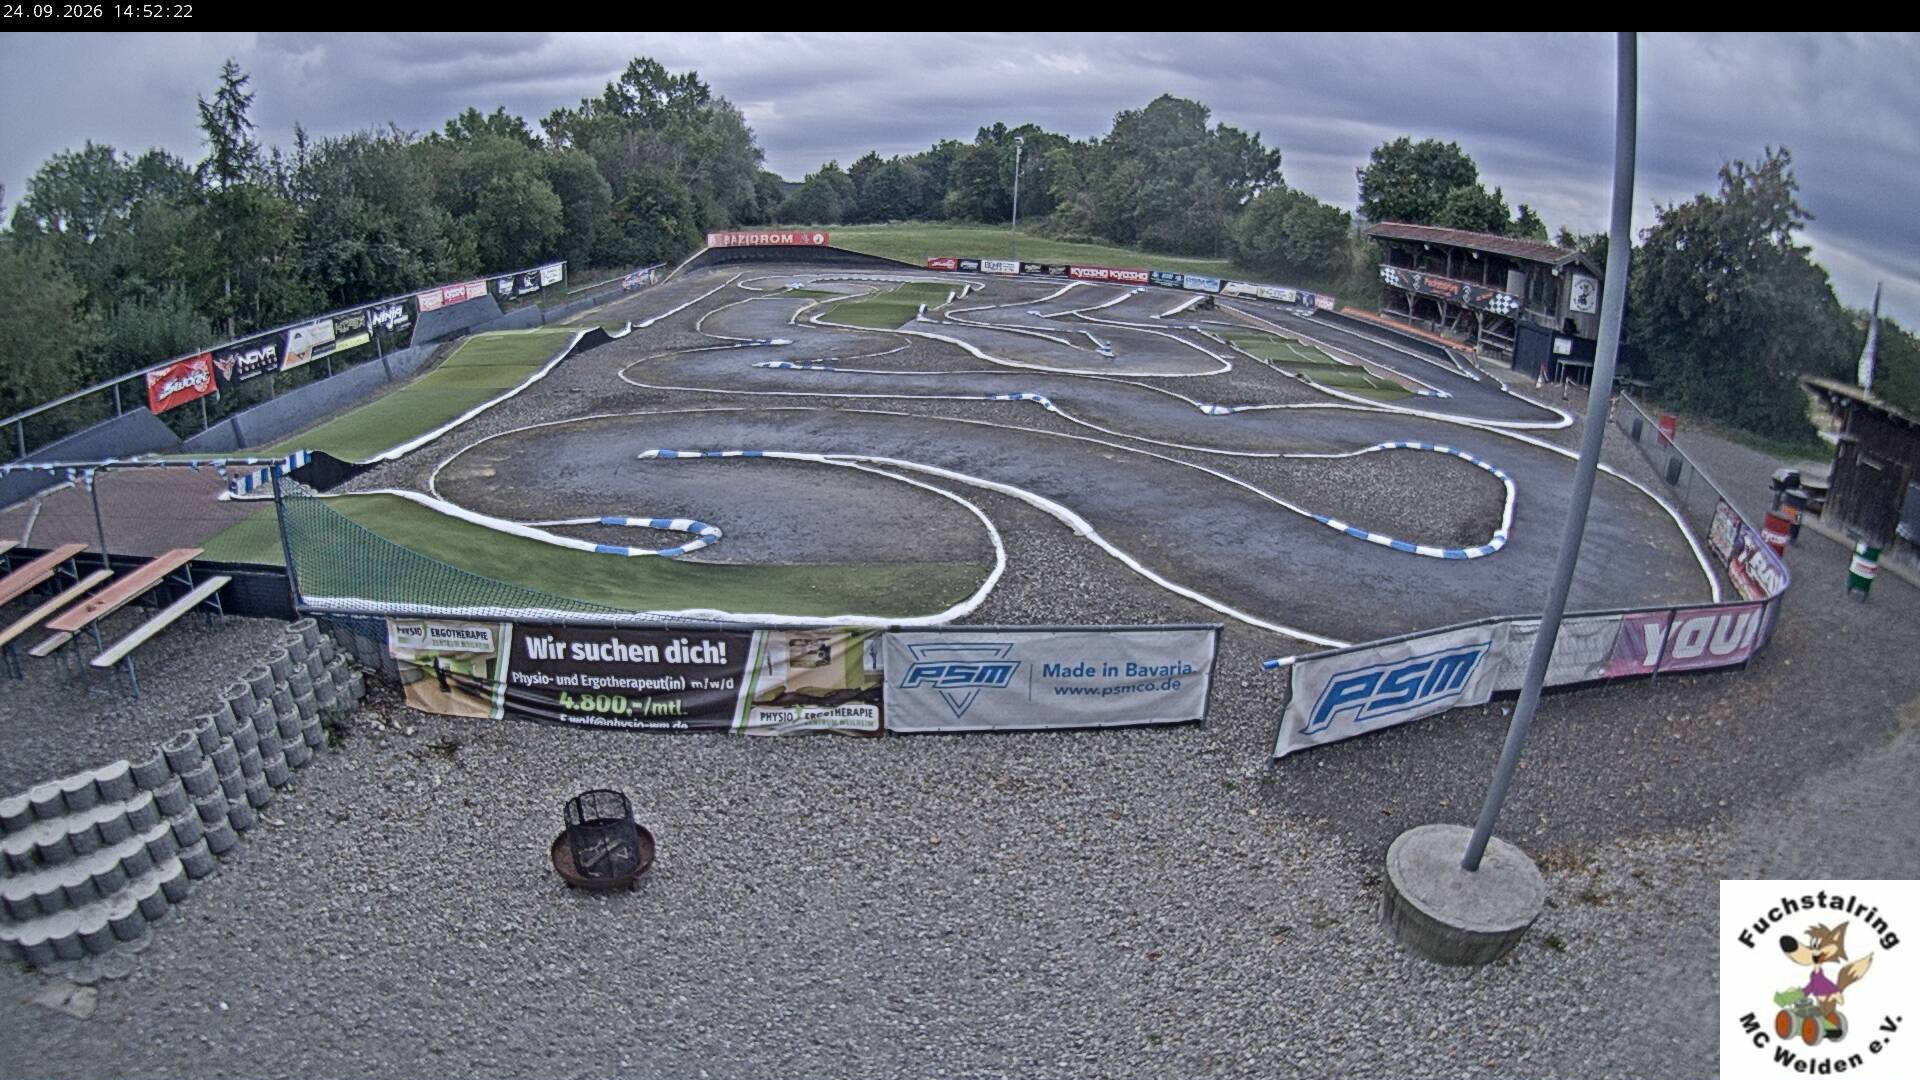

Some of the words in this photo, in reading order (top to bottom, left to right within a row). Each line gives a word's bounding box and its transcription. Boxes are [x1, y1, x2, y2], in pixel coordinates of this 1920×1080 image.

[526, 636, 566, 660] Wir
[571, 638, 659, 663] suchen
[665, 639, 727, 664] dich!
[1042, 663, 1095, 678] Made
[1102, 662, 1118, 677] in
[1125, 660, 1192, 677] Bavaria
[512, 671, 554, 685] Physio-
[556, 673, 578, 685] und
[581, 675, 686, 691] Ergotherapeut(in)
[691, 678, 735, 690] m/w/d
[1054, 680, 1181, 697] www.psmco.de
[1312, 650, 1480, 726] PSM
[760, 712, 794, 721] PHYSIO
[804, 707, 874, 720] ERGOTHERAPIE
